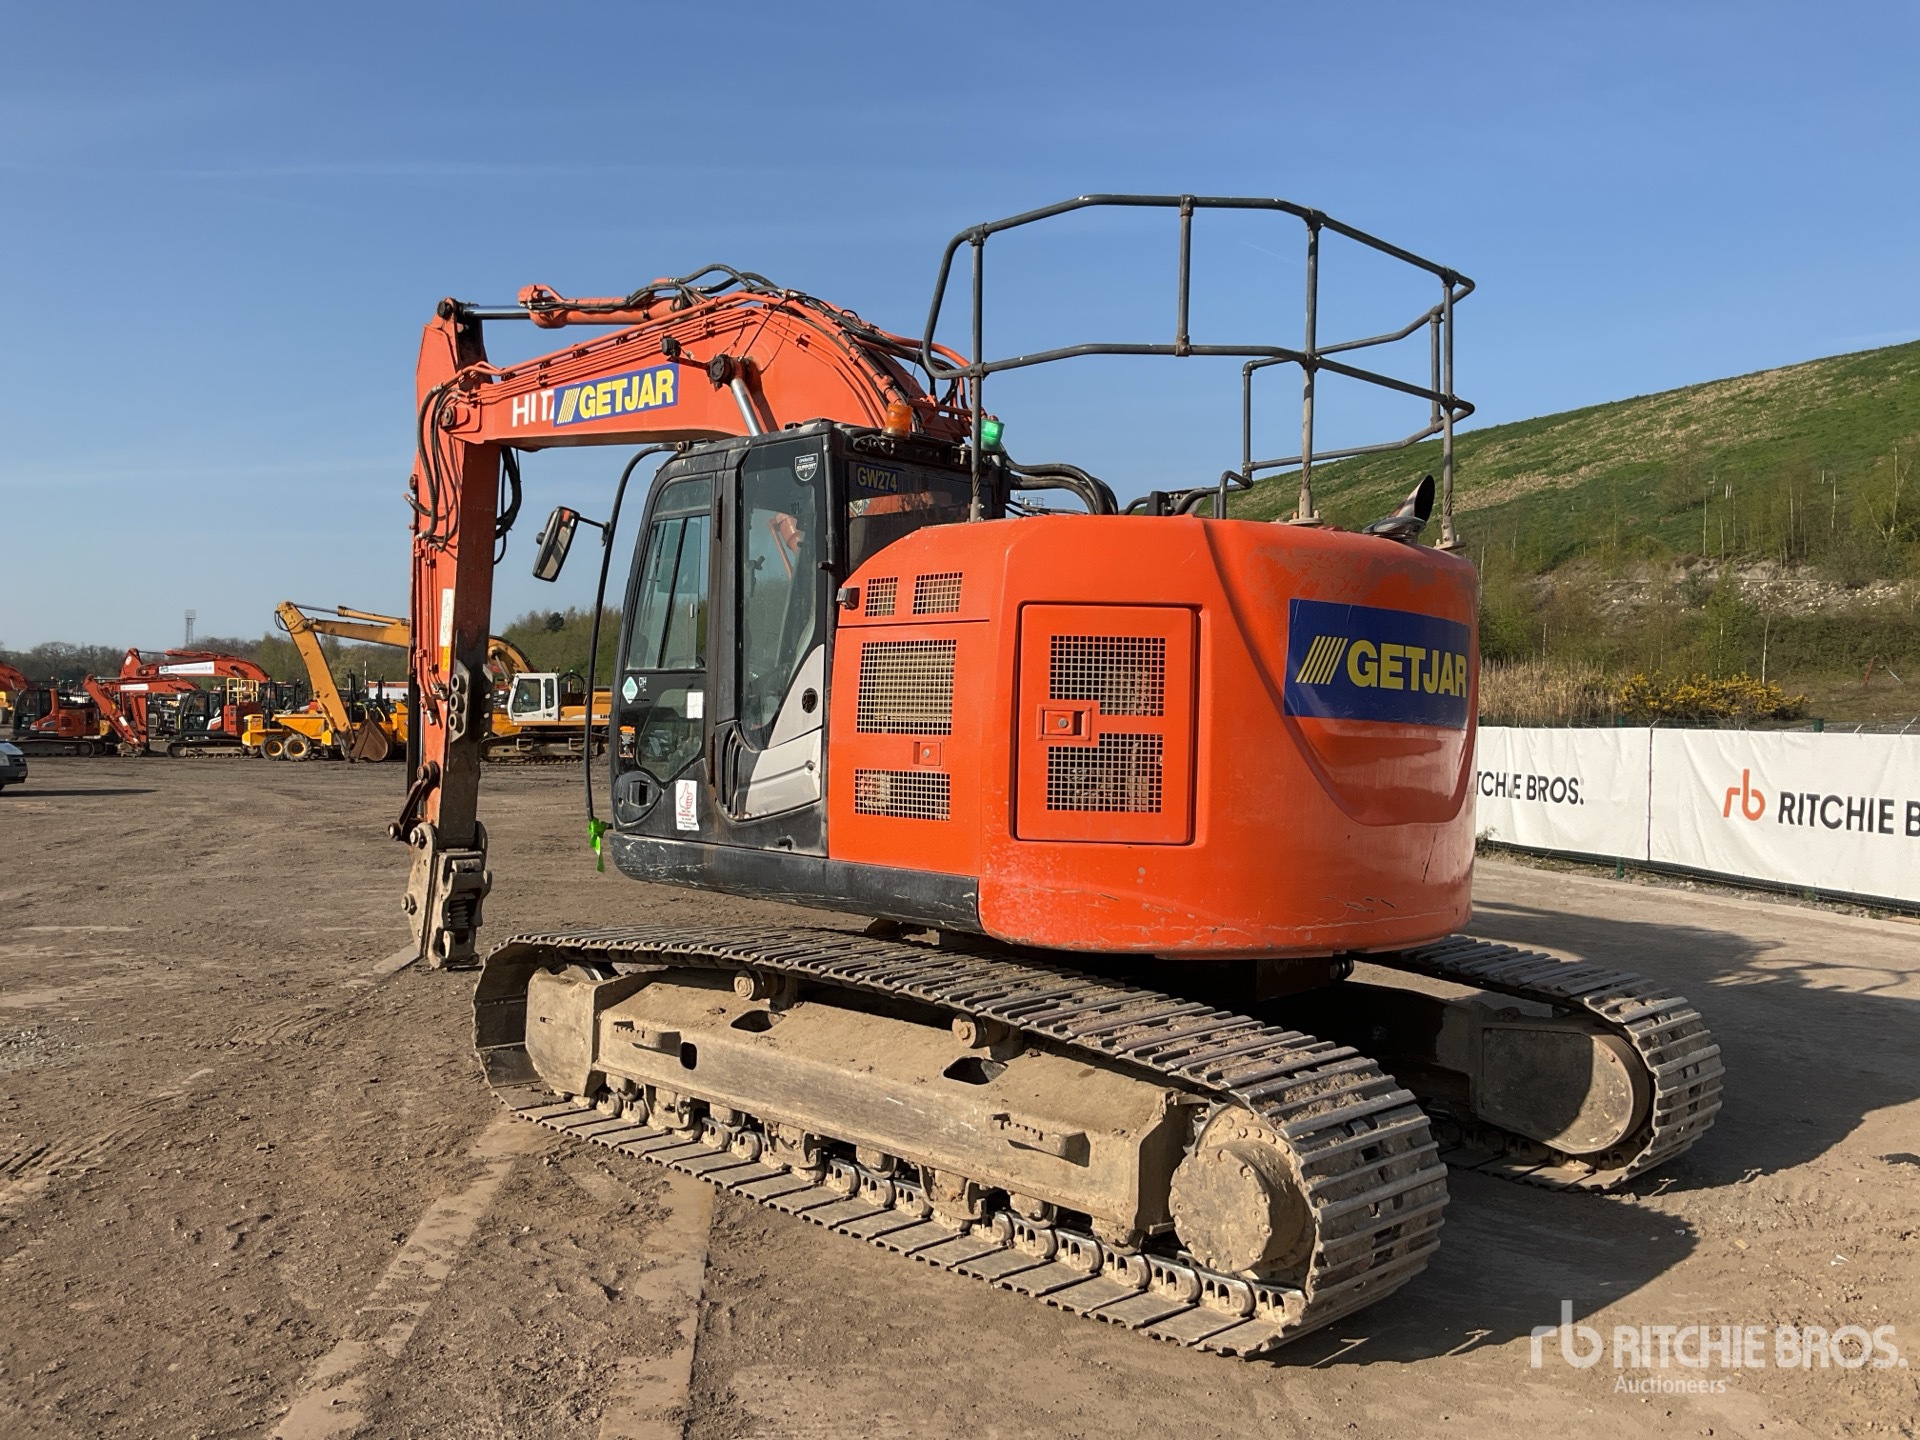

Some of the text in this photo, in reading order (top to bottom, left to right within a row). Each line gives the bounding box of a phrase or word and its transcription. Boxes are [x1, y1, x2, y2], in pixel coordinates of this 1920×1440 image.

[578, 368, 674, 419] GETJAR
[796, 462, 817, 472] SUPPORT
[857, 466, 897, 491] GW274
[1346, 639, 1467, 698] GETJAR
[1526, 775, 1584, 805] BROS.
[1778, 791, 1895, 835] RITCHIE
